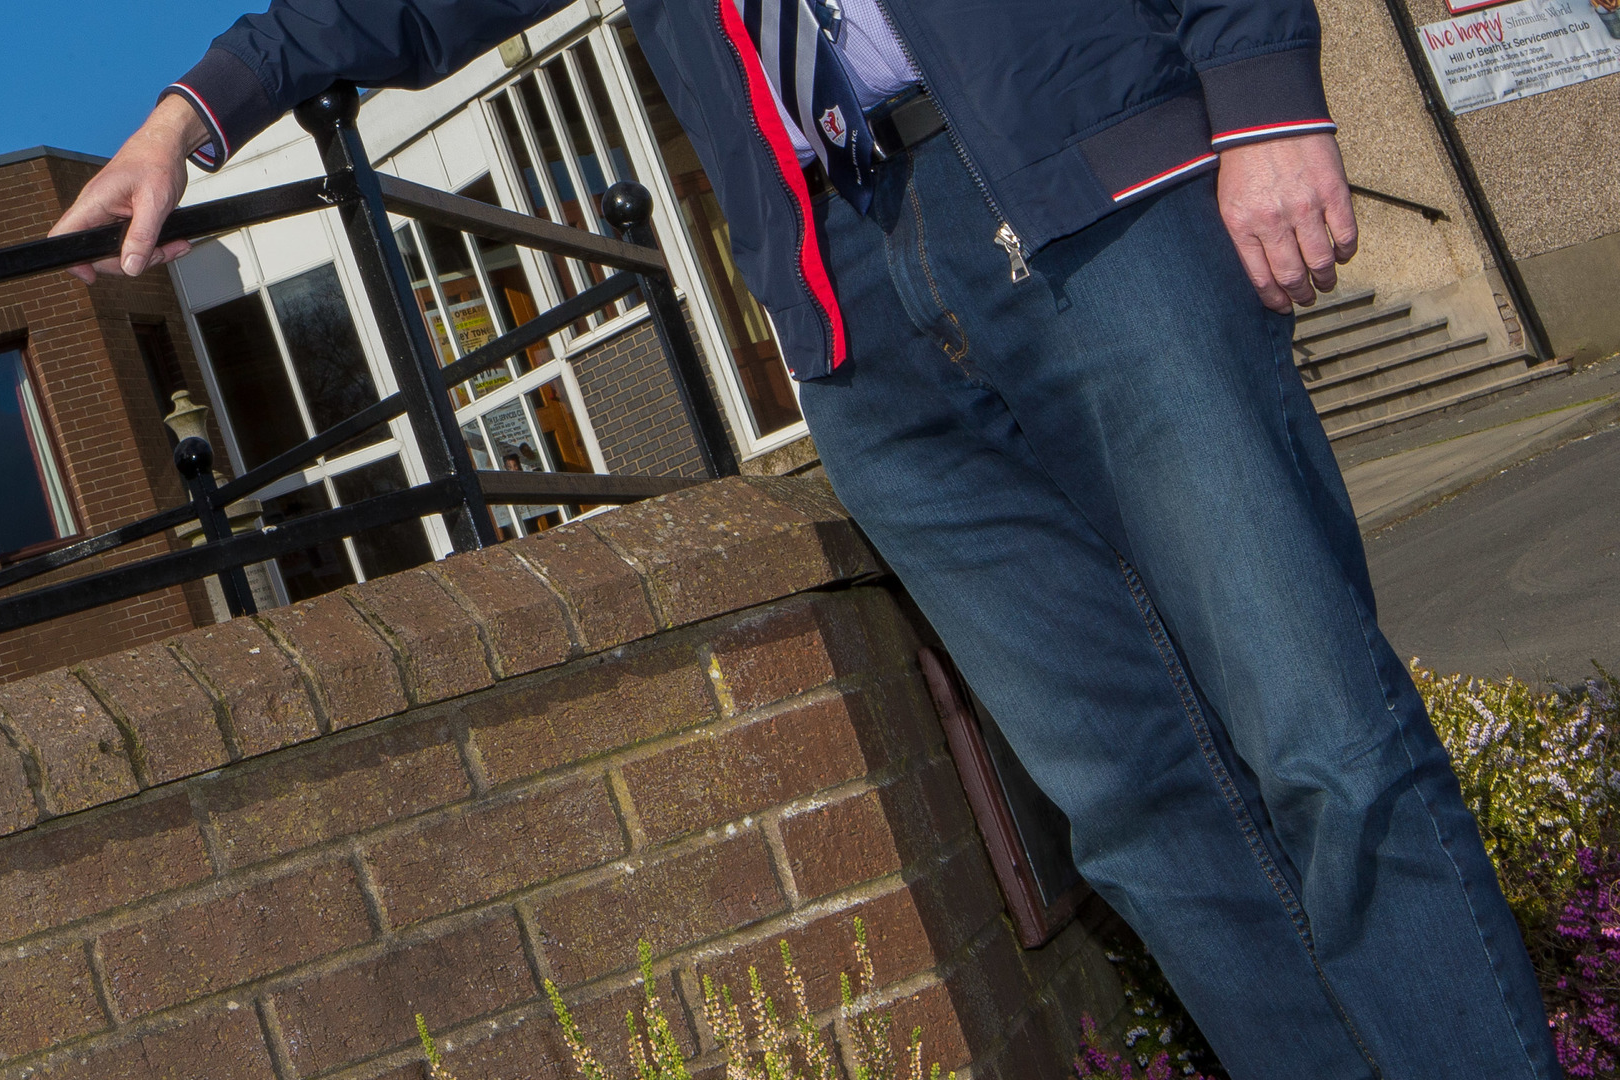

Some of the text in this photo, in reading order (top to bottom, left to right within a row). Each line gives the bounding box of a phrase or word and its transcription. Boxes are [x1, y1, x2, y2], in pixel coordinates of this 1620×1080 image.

[1505, 2, 1573, 30] Slimming World
[1424, 12, 1504, 51] live happy!
[1449, 20, 1591, 64] Hill of Beath Ex Servicemens Club
[1444, 65, 1472, 76] Monday's
[1460, 73, 1477, 82] Agata
[1521, 58, 1535, 67] more
[1535, 53, 1554, 62] details
[1582, 60, 1597, 69] more
[1597, 55, 1616, 64] details
